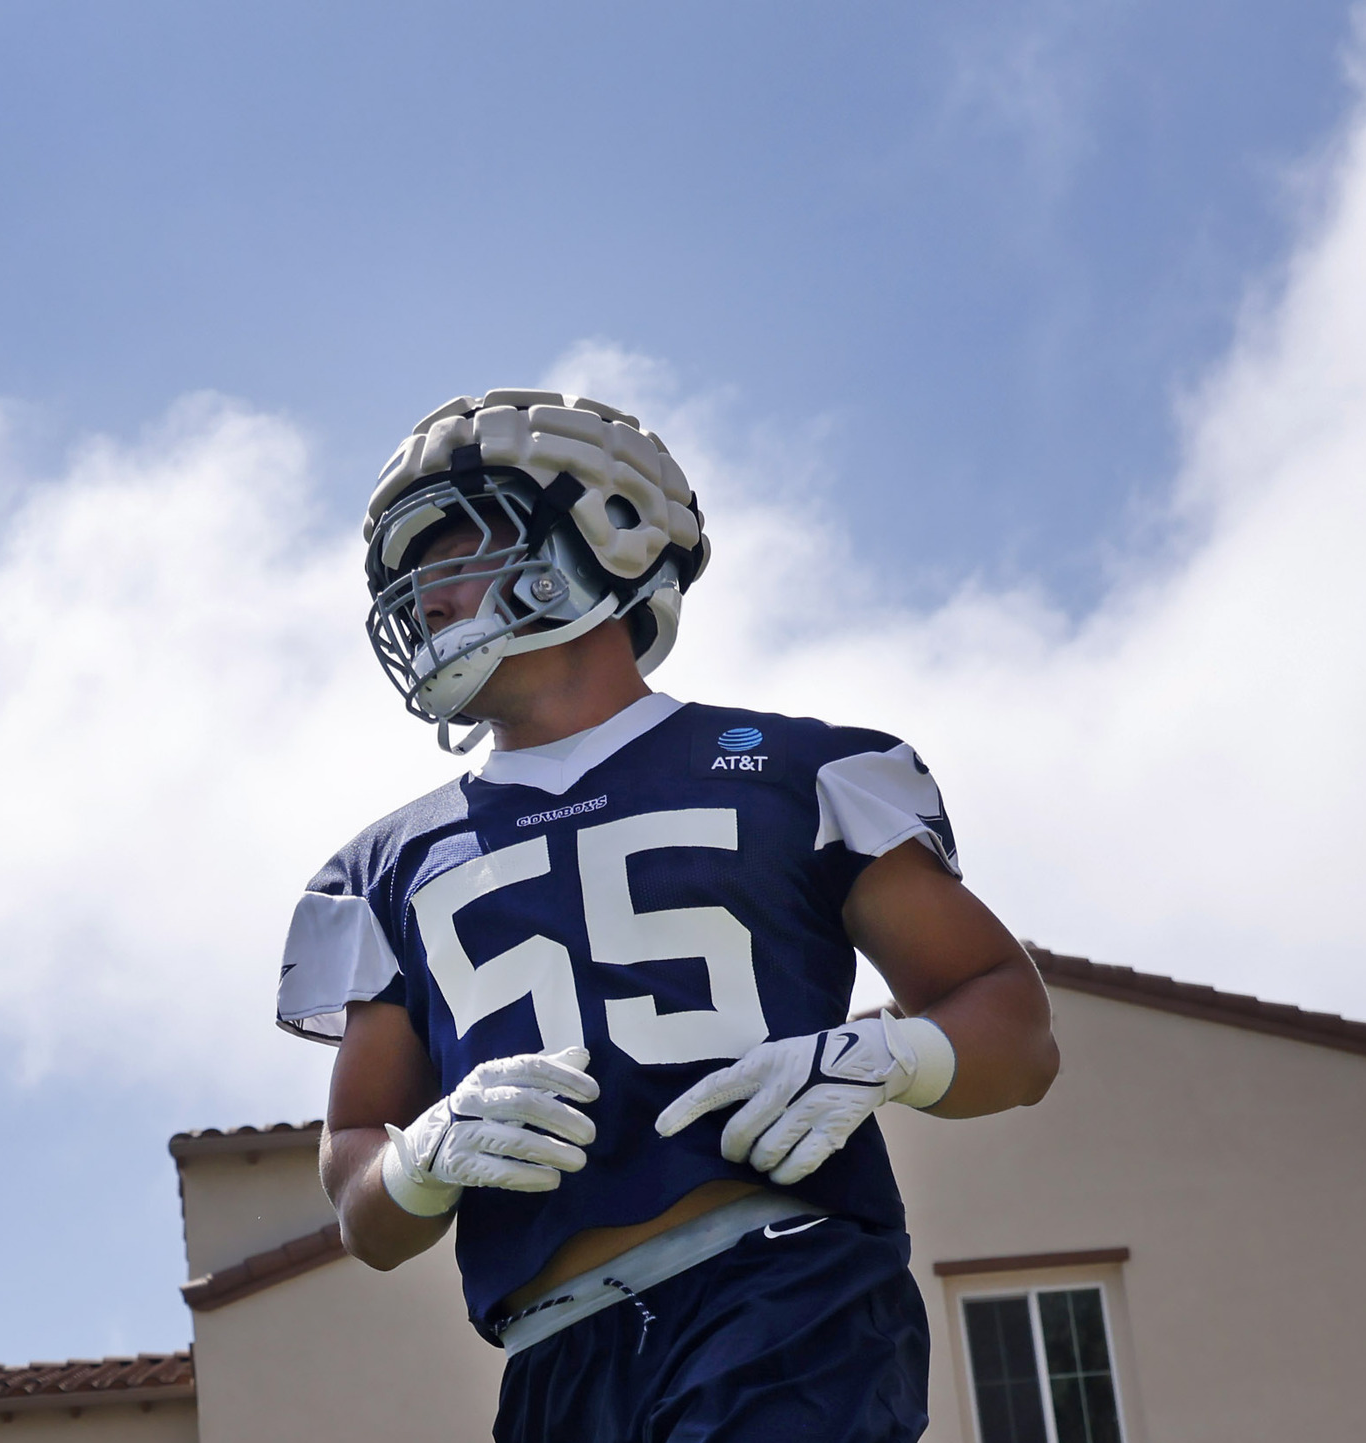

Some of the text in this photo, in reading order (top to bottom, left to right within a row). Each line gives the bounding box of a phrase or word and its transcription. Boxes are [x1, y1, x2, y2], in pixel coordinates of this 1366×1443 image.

[711, 755, 768, 771] AT&T
[516, 795, 607, 827] COWBOYS
[410, 808, 770, 1064] 55
